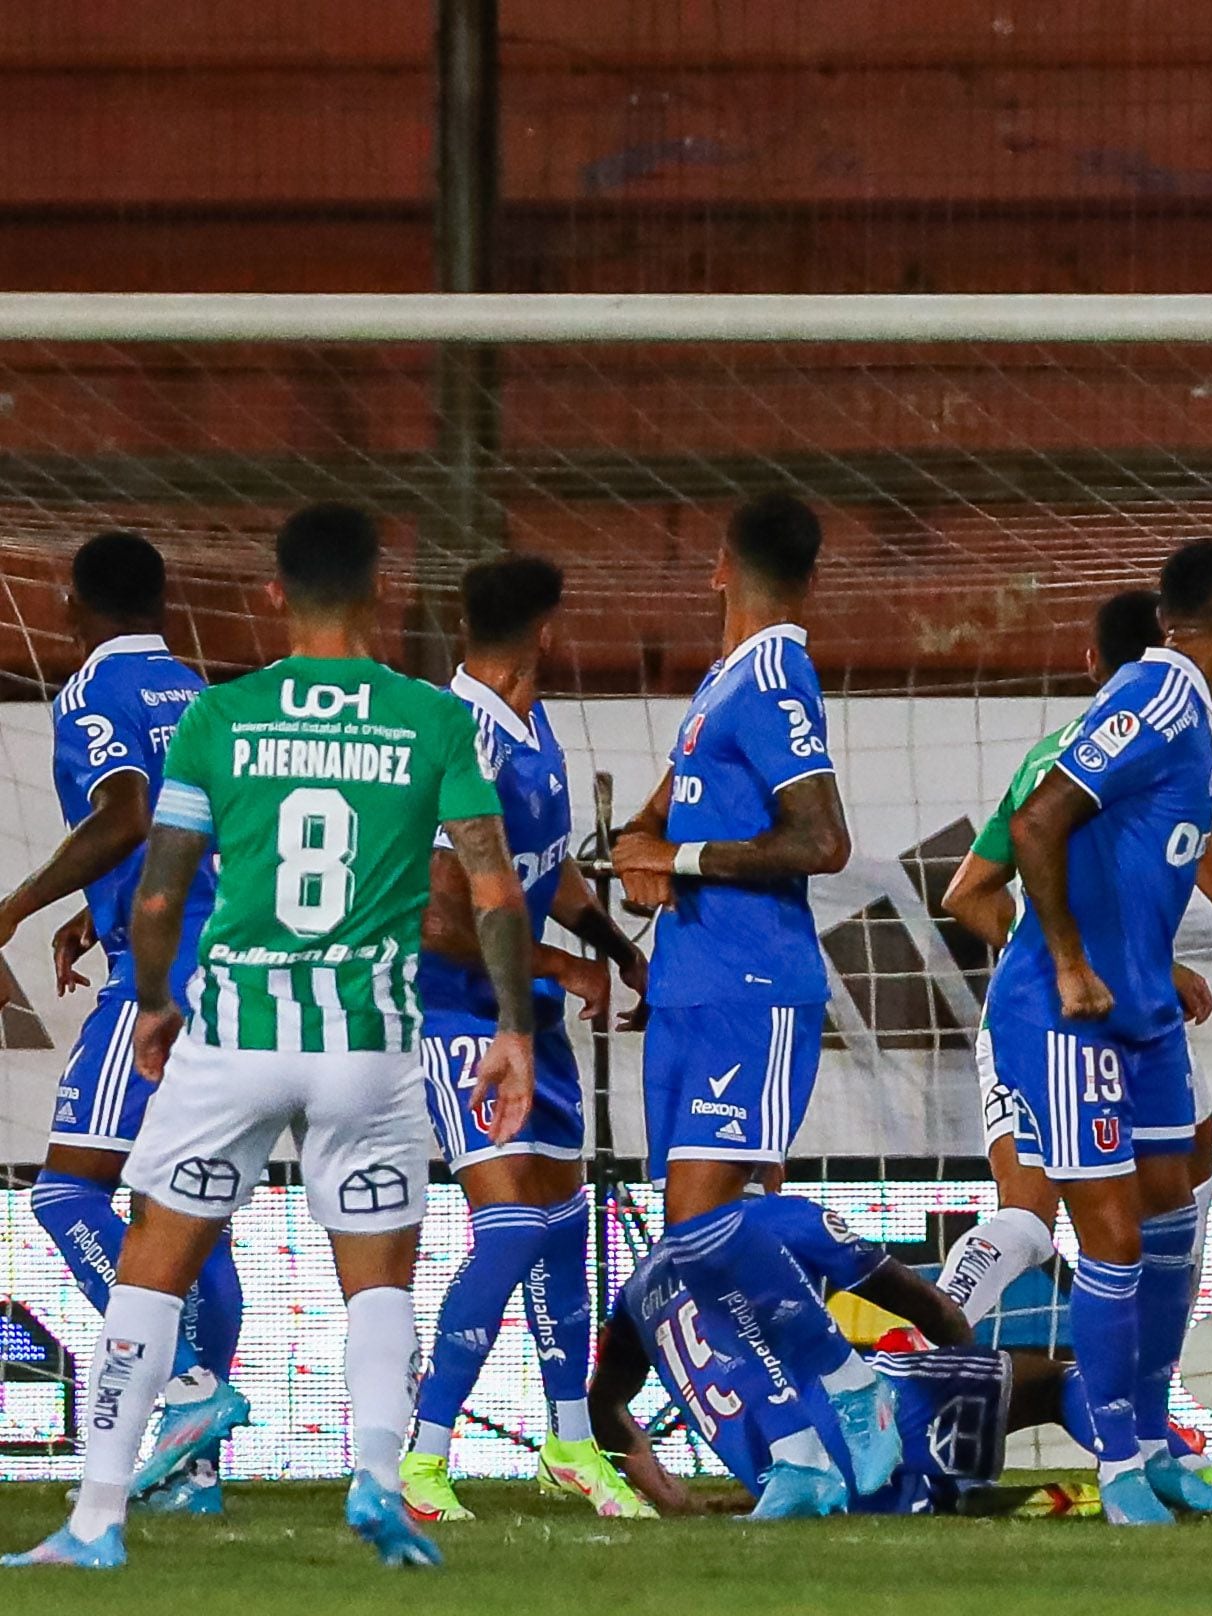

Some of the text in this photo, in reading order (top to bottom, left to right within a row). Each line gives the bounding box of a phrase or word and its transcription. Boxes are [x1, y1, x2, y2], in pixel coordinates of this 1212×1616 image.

[231, 721, 299, 734] Universidad
[344, 723, 359, 735] de
[232, 738, 412, 785] P.HERNANDEZ
[276, 787, 359, 938] 8
[1082, 1046, 1123, 1102] 19
[691, 1099, 747, 1120] Rexona
